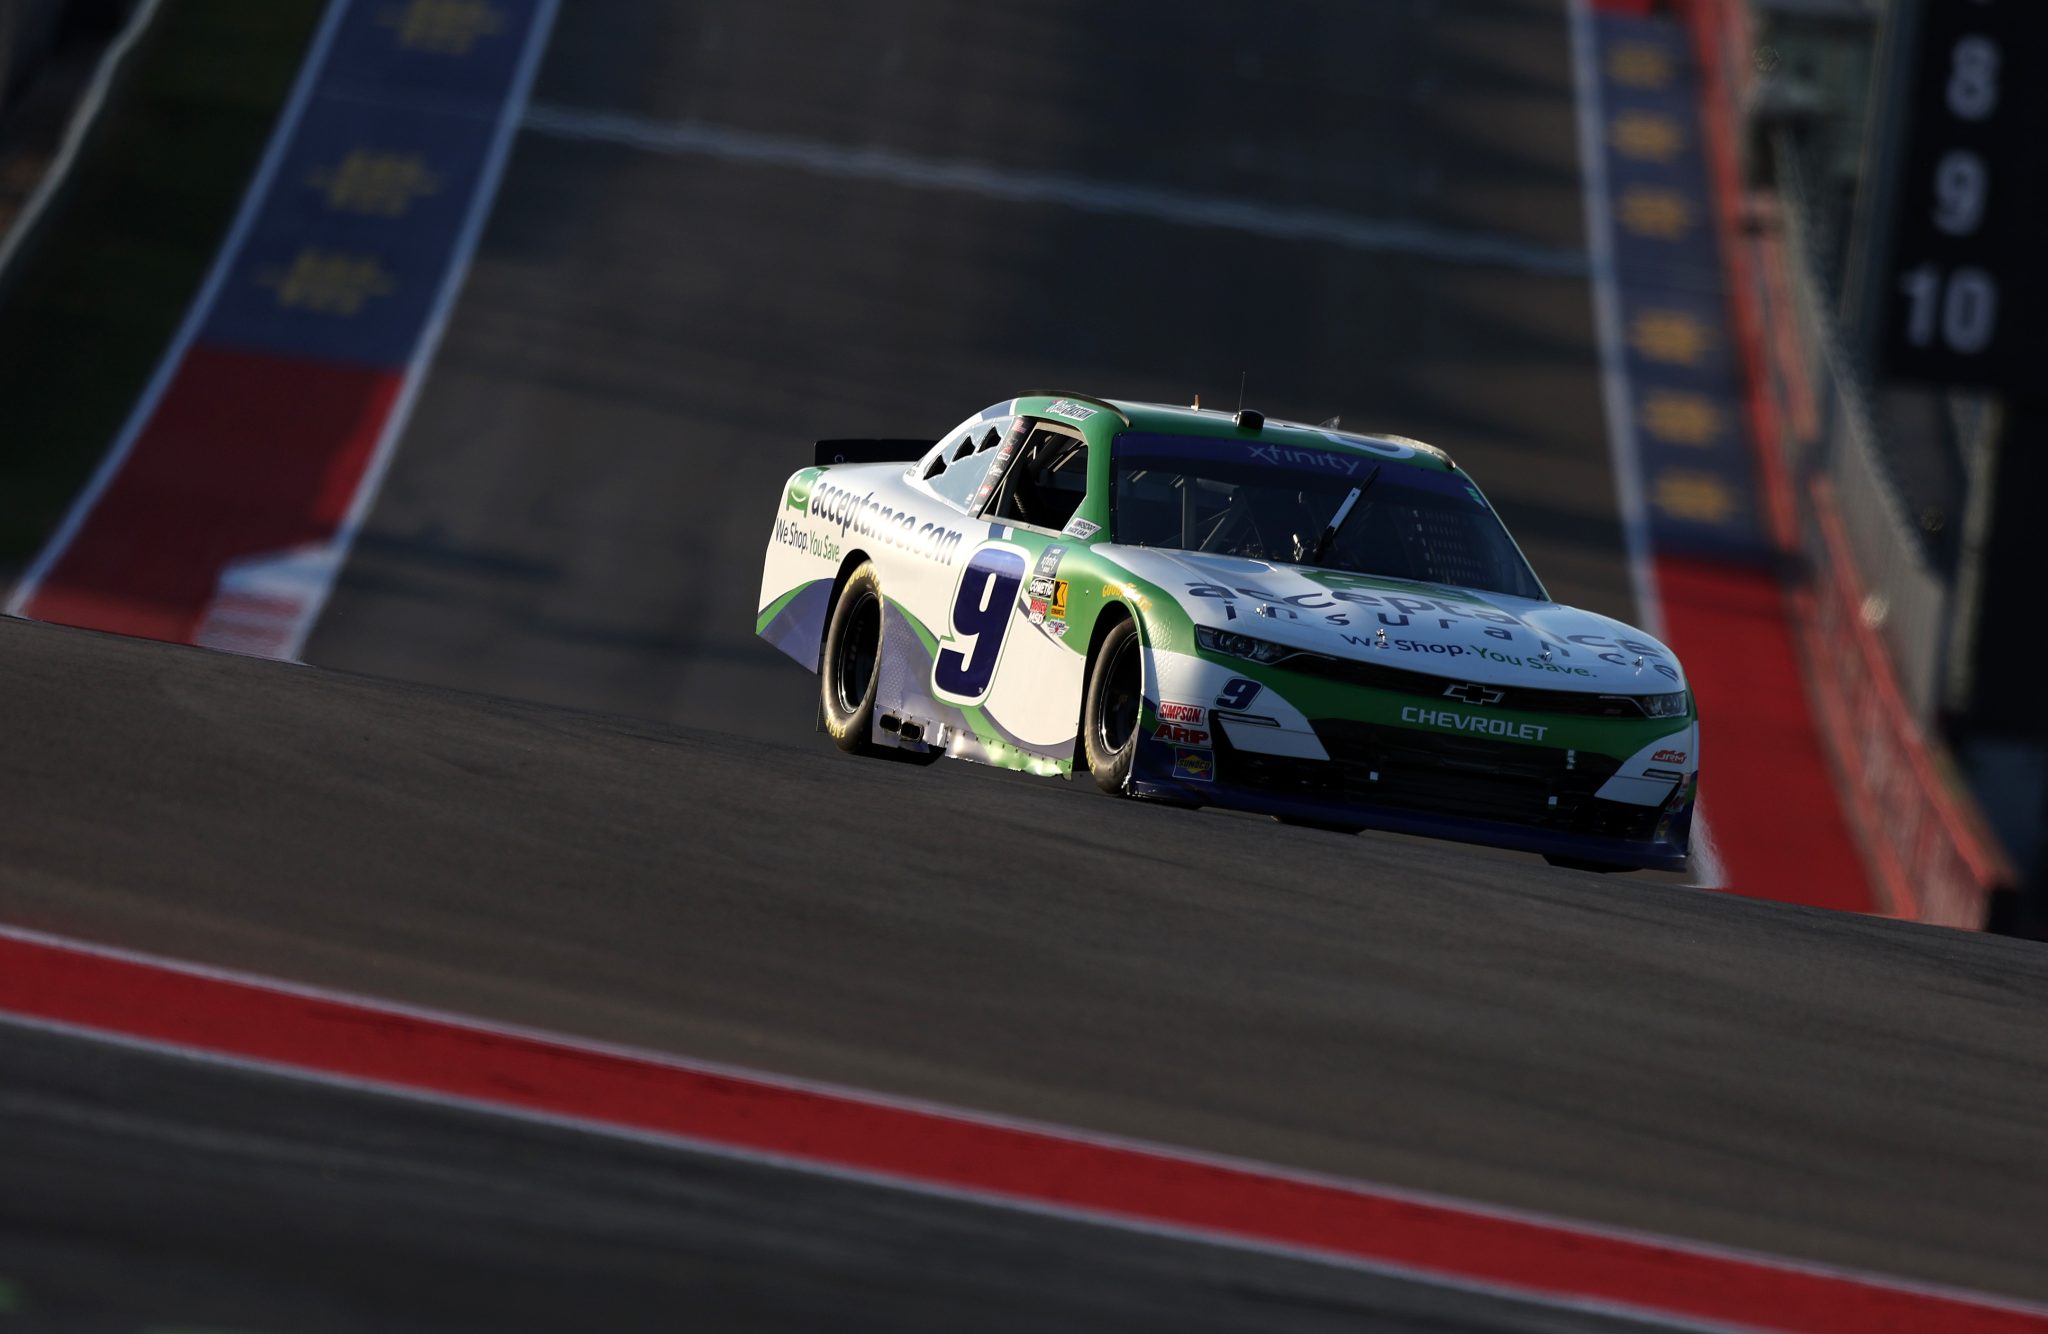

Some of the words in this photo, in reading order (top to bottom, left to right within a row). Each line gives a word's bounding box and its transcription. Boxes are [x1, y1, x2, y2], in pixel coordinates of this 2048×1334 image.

[1945, 34, 1998, 120] 8
[1932, 147, 1988, 236] 9
[1903, 266, 1997, 353] 10
[1247, 444, 1359, 475] xfinity
[775, 517, 789, 545] We
[789, 522, 808, 555] Shop.
[808, 530, 822, 558] You
[822, 535, 841, 563] Save.
[811, 482, 962, 566] acceptance.com
[934, 547, 1026, 698] 9
[1340, 634, 1390, 649] We
[1397, 639, 1470, 657] Shop.
[1470, 645, 1522, 667] You
[1527, 657, 1599, 678] Save.
[1160, 703, 1202, 723] SIMPSON
[1215, 678, 1262, 710] 9
[1155, 722, 1210, 745] ARP
[1401, 706, 1548, 741] CHEVROLET
